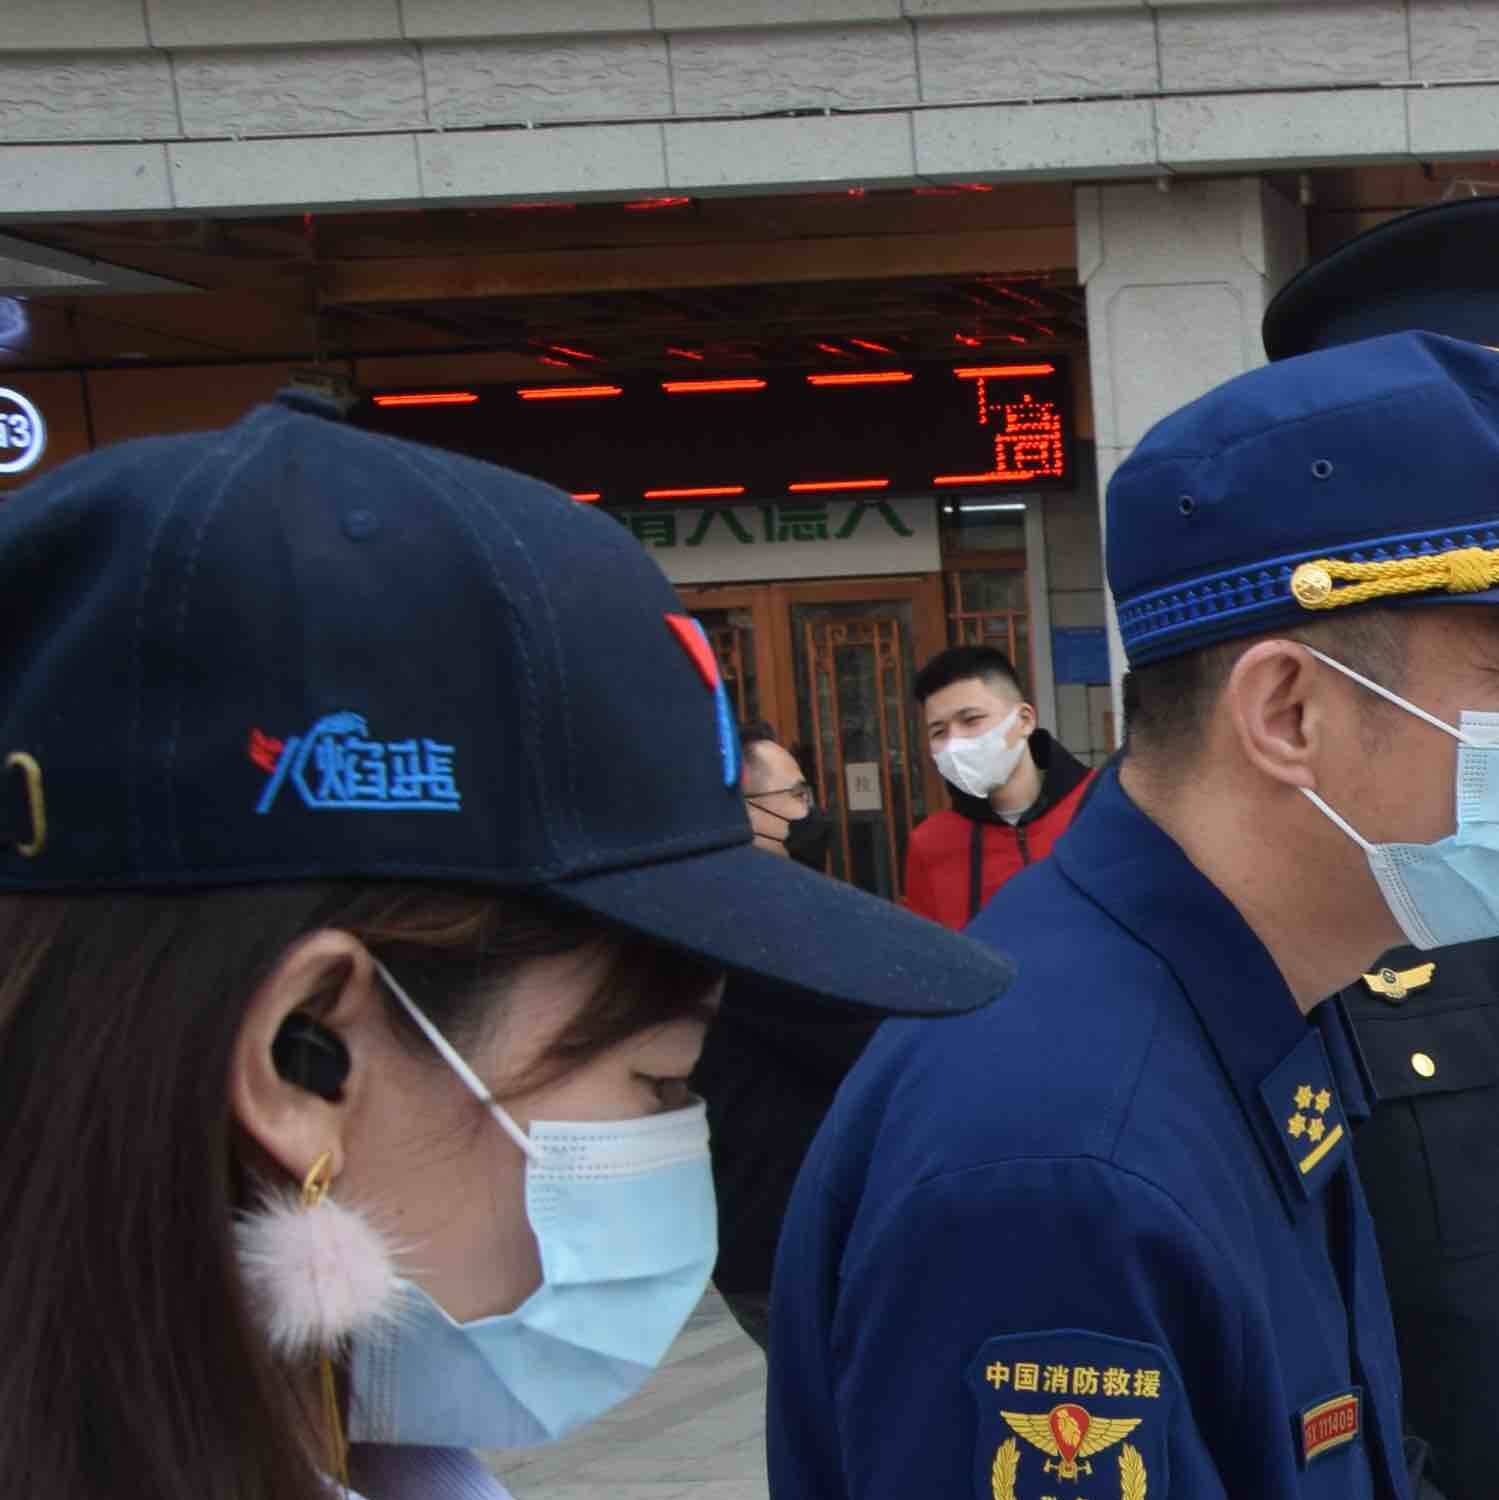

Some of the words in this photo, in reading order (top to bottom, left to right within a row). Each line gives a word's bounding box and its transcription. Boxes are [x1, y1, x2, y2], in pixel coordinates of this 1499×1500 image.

[984, 1360, 1162, 1399] 中国消防救援
